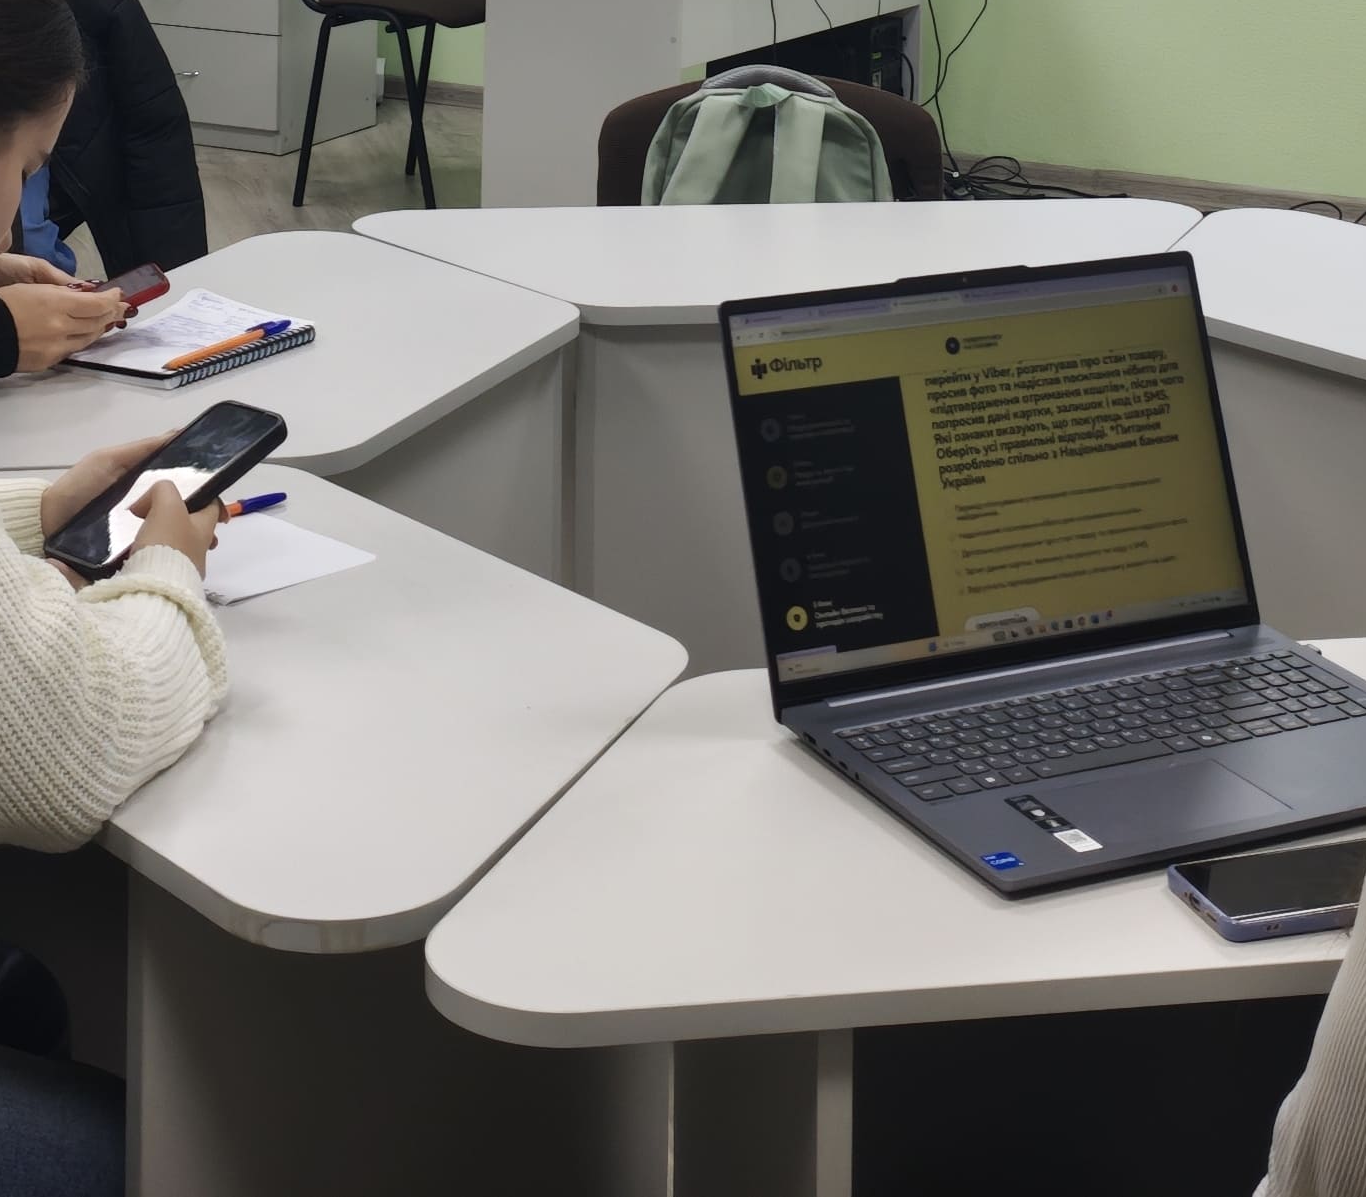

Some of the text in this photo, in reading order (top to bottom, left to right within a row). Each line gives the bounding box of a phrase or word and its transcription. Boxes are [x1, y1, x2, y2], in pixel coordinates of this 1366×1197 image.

[769, 355, 822, 374] Фільтр
[1080, 356, 1100, 369] про
[969, 382, 997, 398] фото
[999, 381, 1011, 391] та
